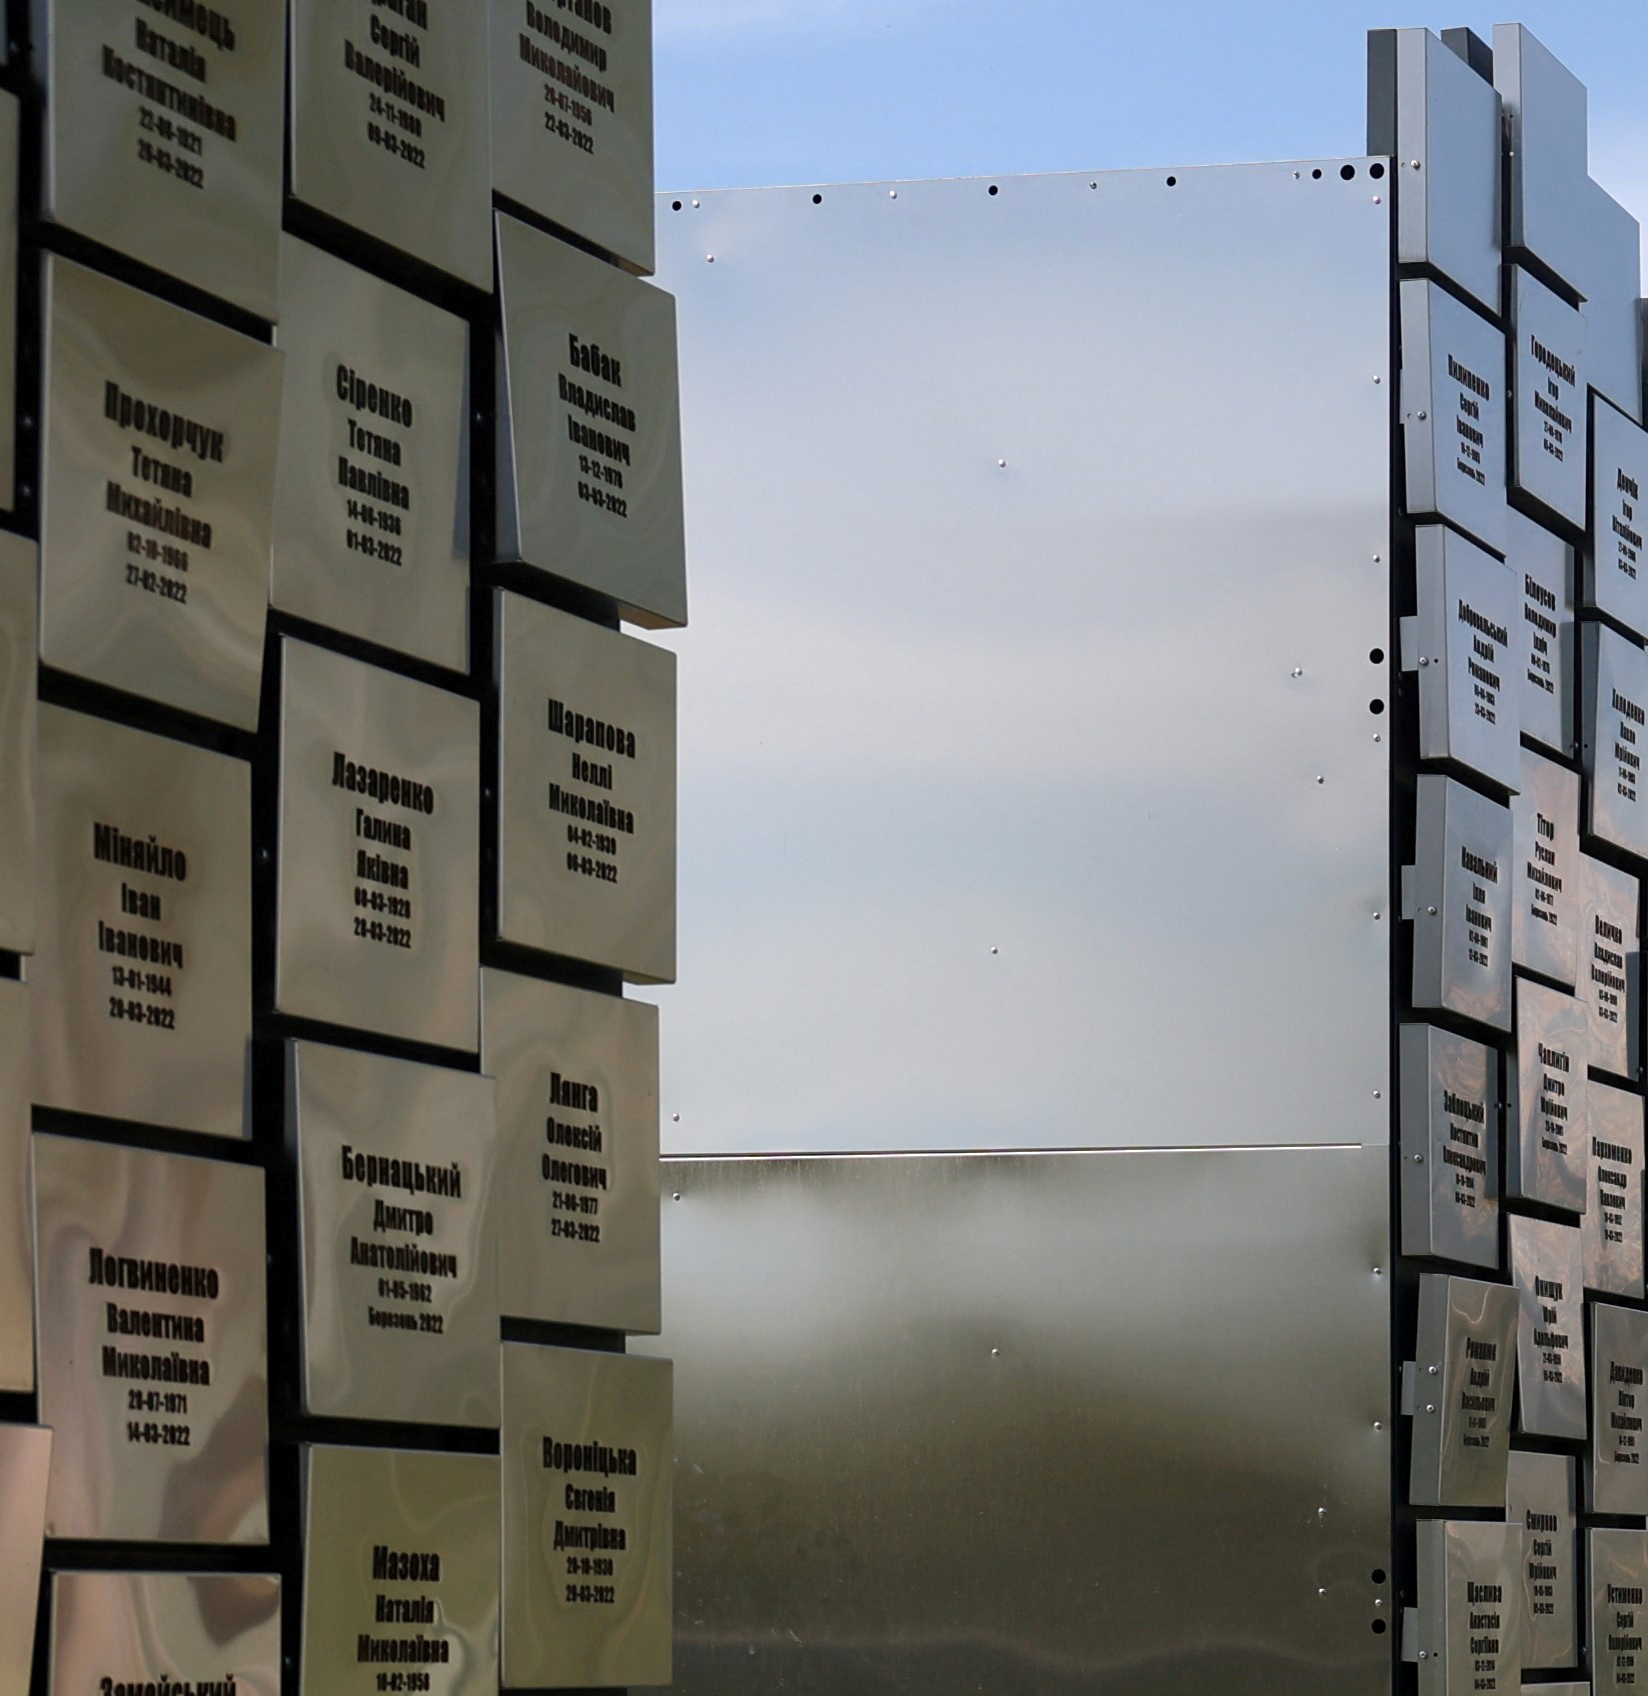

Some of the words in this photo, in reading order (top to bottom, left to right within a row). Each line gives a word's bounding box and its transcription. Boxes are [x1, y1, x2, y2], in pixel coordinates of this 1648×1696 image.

[370, 14, 420, 68] Сергій
[526, 0, 606, 72] Володимир
[345, 40, 444, 122] Валерійович
[520, 33, 614, 112] Миколайович
[569, 333, 622, 387] Бабак
[336, 364, 412, 428] Сіренко
[558, 373, 636, 432] Владислав
[104, 380, 224, 463] Прохорчук
[348, 418, 400, 466] Тетяна
[568, 414, 630, 466] Іванович
[132, 446, 192, 498] Тетяна
[338, 456, 409, 510] Павлівна
[106, 481, 212, 549] Михайлівна
[548, 698, 635, 758] Шарапова
[332, 752, 434, 814] Лазаренко
[572, 752, 612, 790] Неллі
[356, 808, 410, 850] Галина
[549, 782, 634, 834] Миколаївна
[94, 822, 186, 882] Міняйло
[356, 850, 408, 890] Яківна
[122, 882, 160, 921] Іван
[98, 920, 183, 969] Іванович
[550, 1072, 598, 1112] Лянга
[546, 1117, 602, 1152] Олексій
[342, 1145, 461, 1198] Бернацький
[542, 1154, 606, 1190] Олегович
[374, 1199, 434, 1236] Дмитро
[89, 1247, 218, 1300] Логвиненко
[350, 1236, 457, 1278] Анатолійович
[106, 1302, 204, 1342] Валентина
[419, 1312, 443, 1334] 2022
[102, 1346, 210, 1386] Миколаївна
[127, 1422, 190, 1446] 14-03-2022
[543, 1436, 636, 1478] Вороніцька
[566, 1484, 615, 1512] Євгенія
[554, 1520, 626, 1552] Дмитрівна
[372, 1546, 440, 1582] Мазоха
[376, 1594, 434, 1624] Наталія
[358, 1634, 448, 1663] Миколаївна
